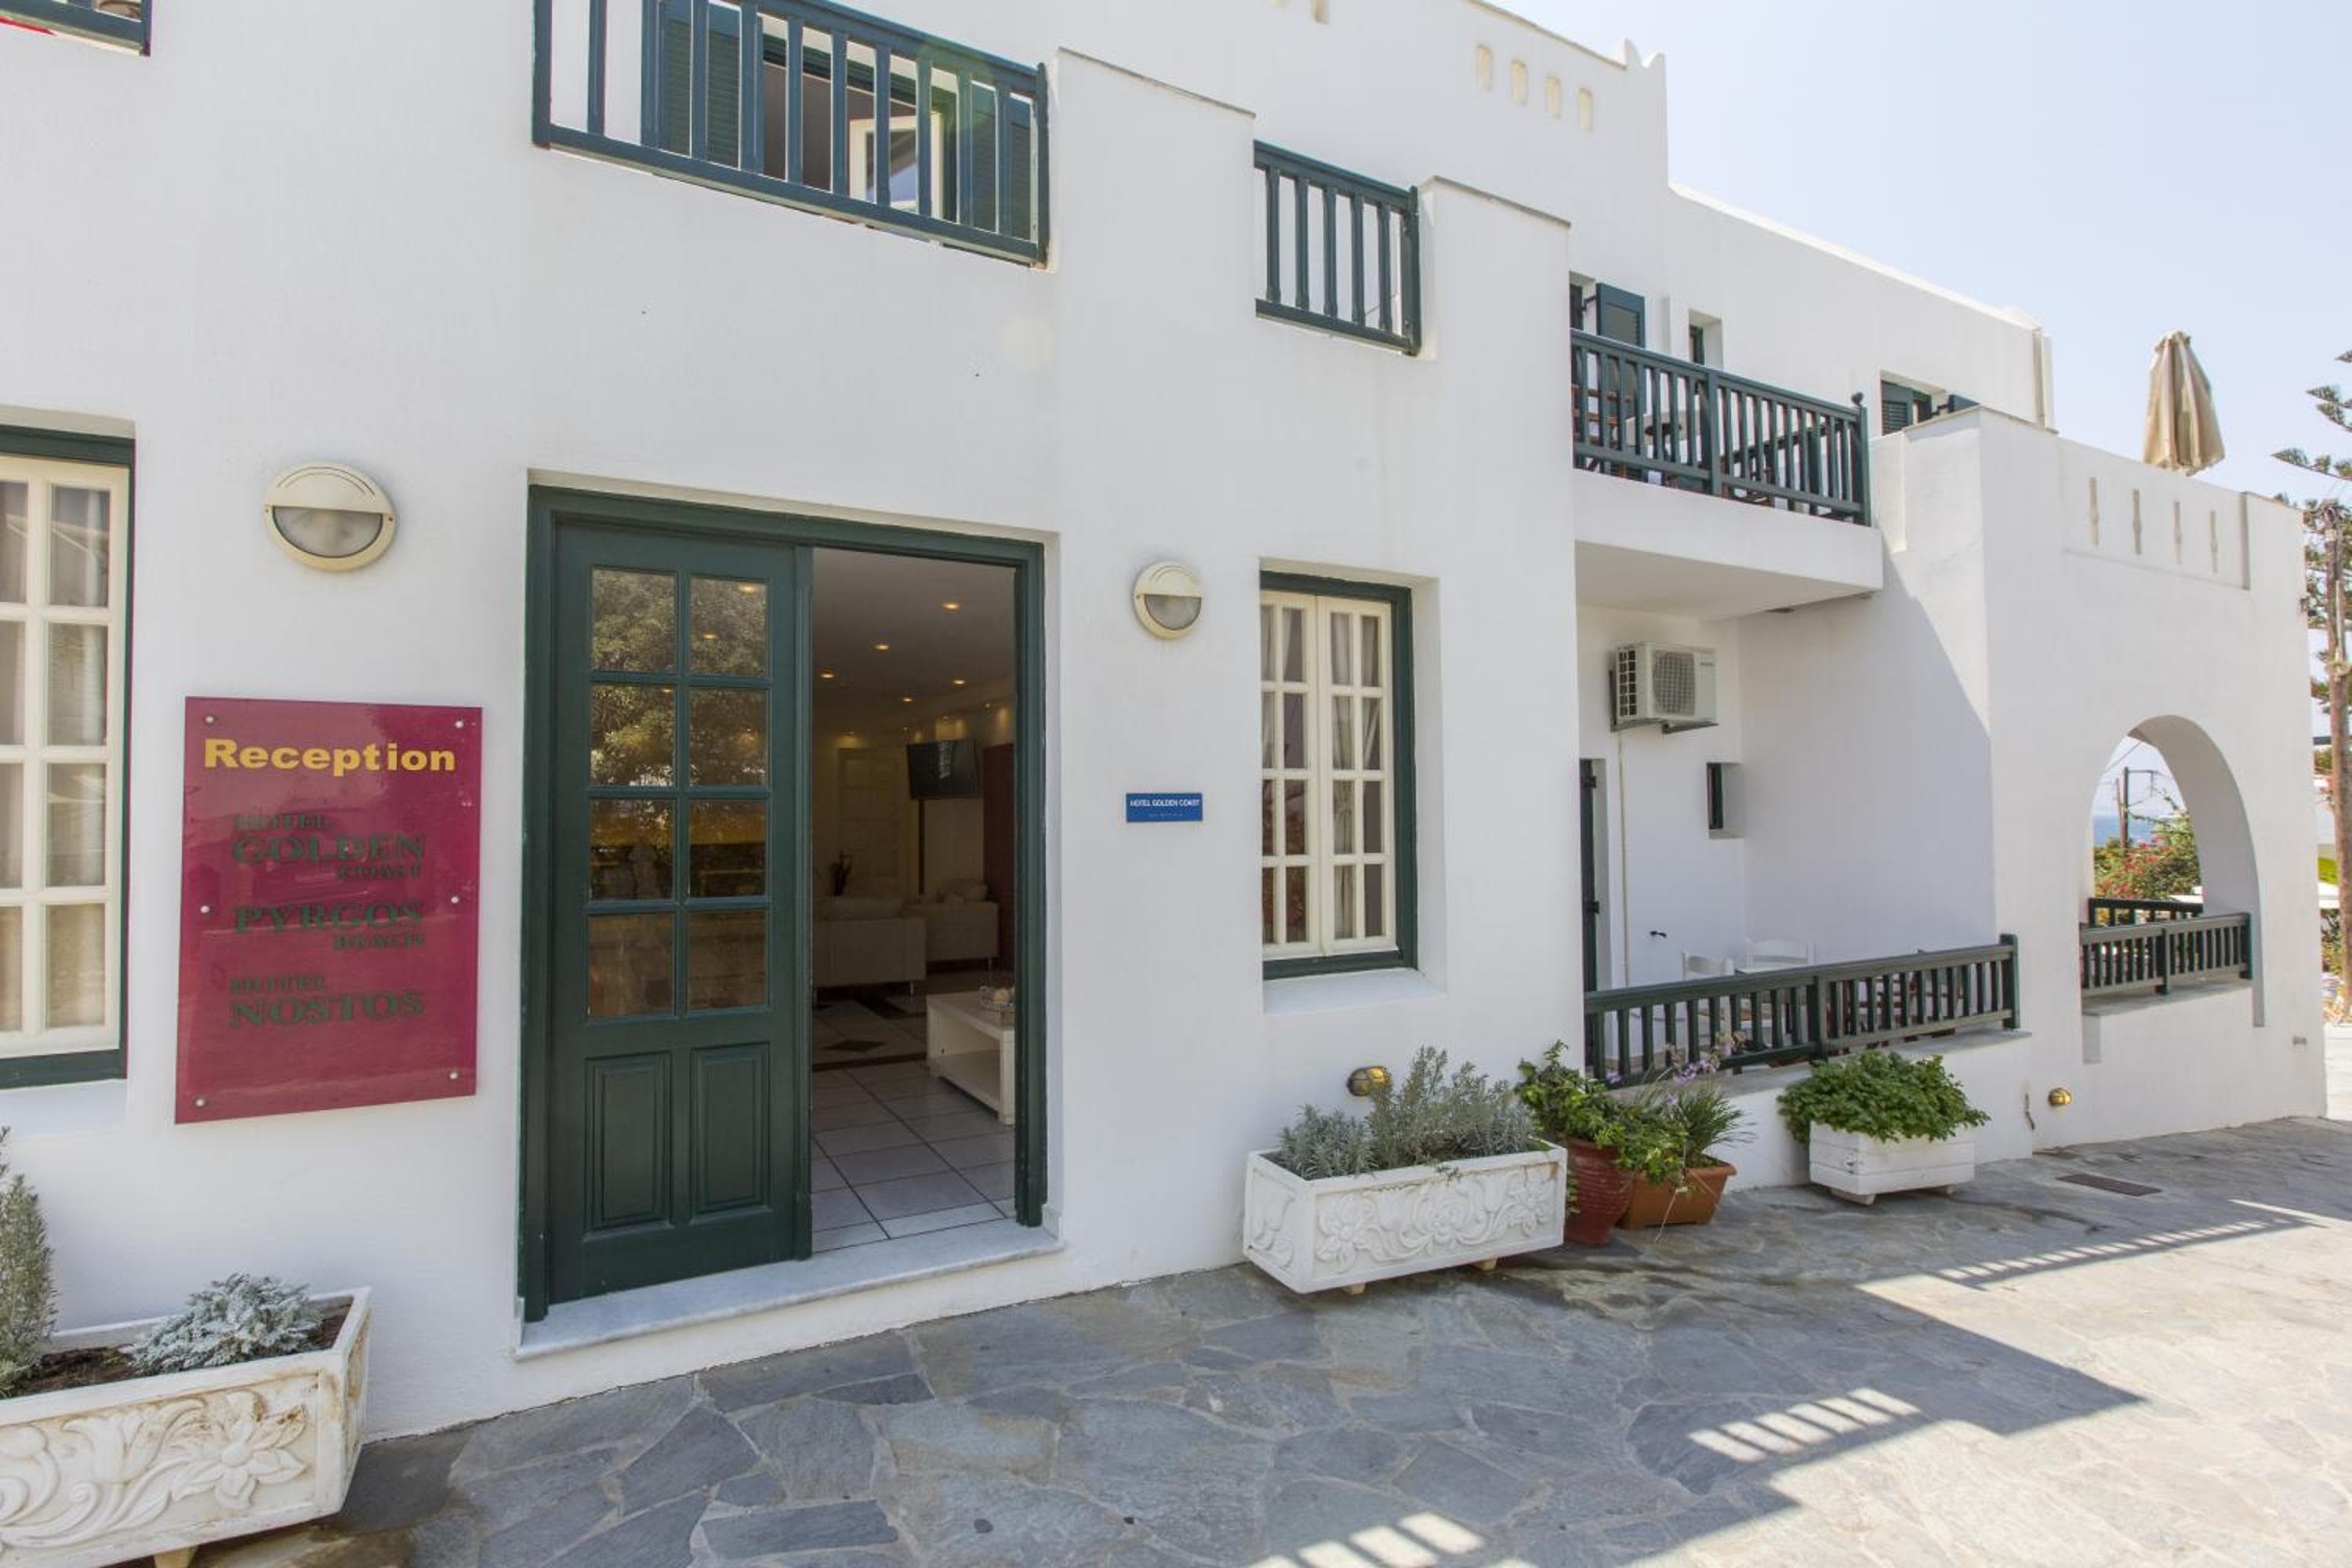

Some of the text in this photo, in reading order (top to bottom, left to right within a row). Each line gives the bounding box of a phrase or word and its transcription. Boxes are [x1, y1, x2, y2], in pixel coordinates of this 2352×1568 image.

[204, 739, 456, 778] Reception
[232, 833, 426, 865] GOLDEN
[234, 902, 424, 934] PYRGOS
[230, 991, 425, 1029] NOSTOS
